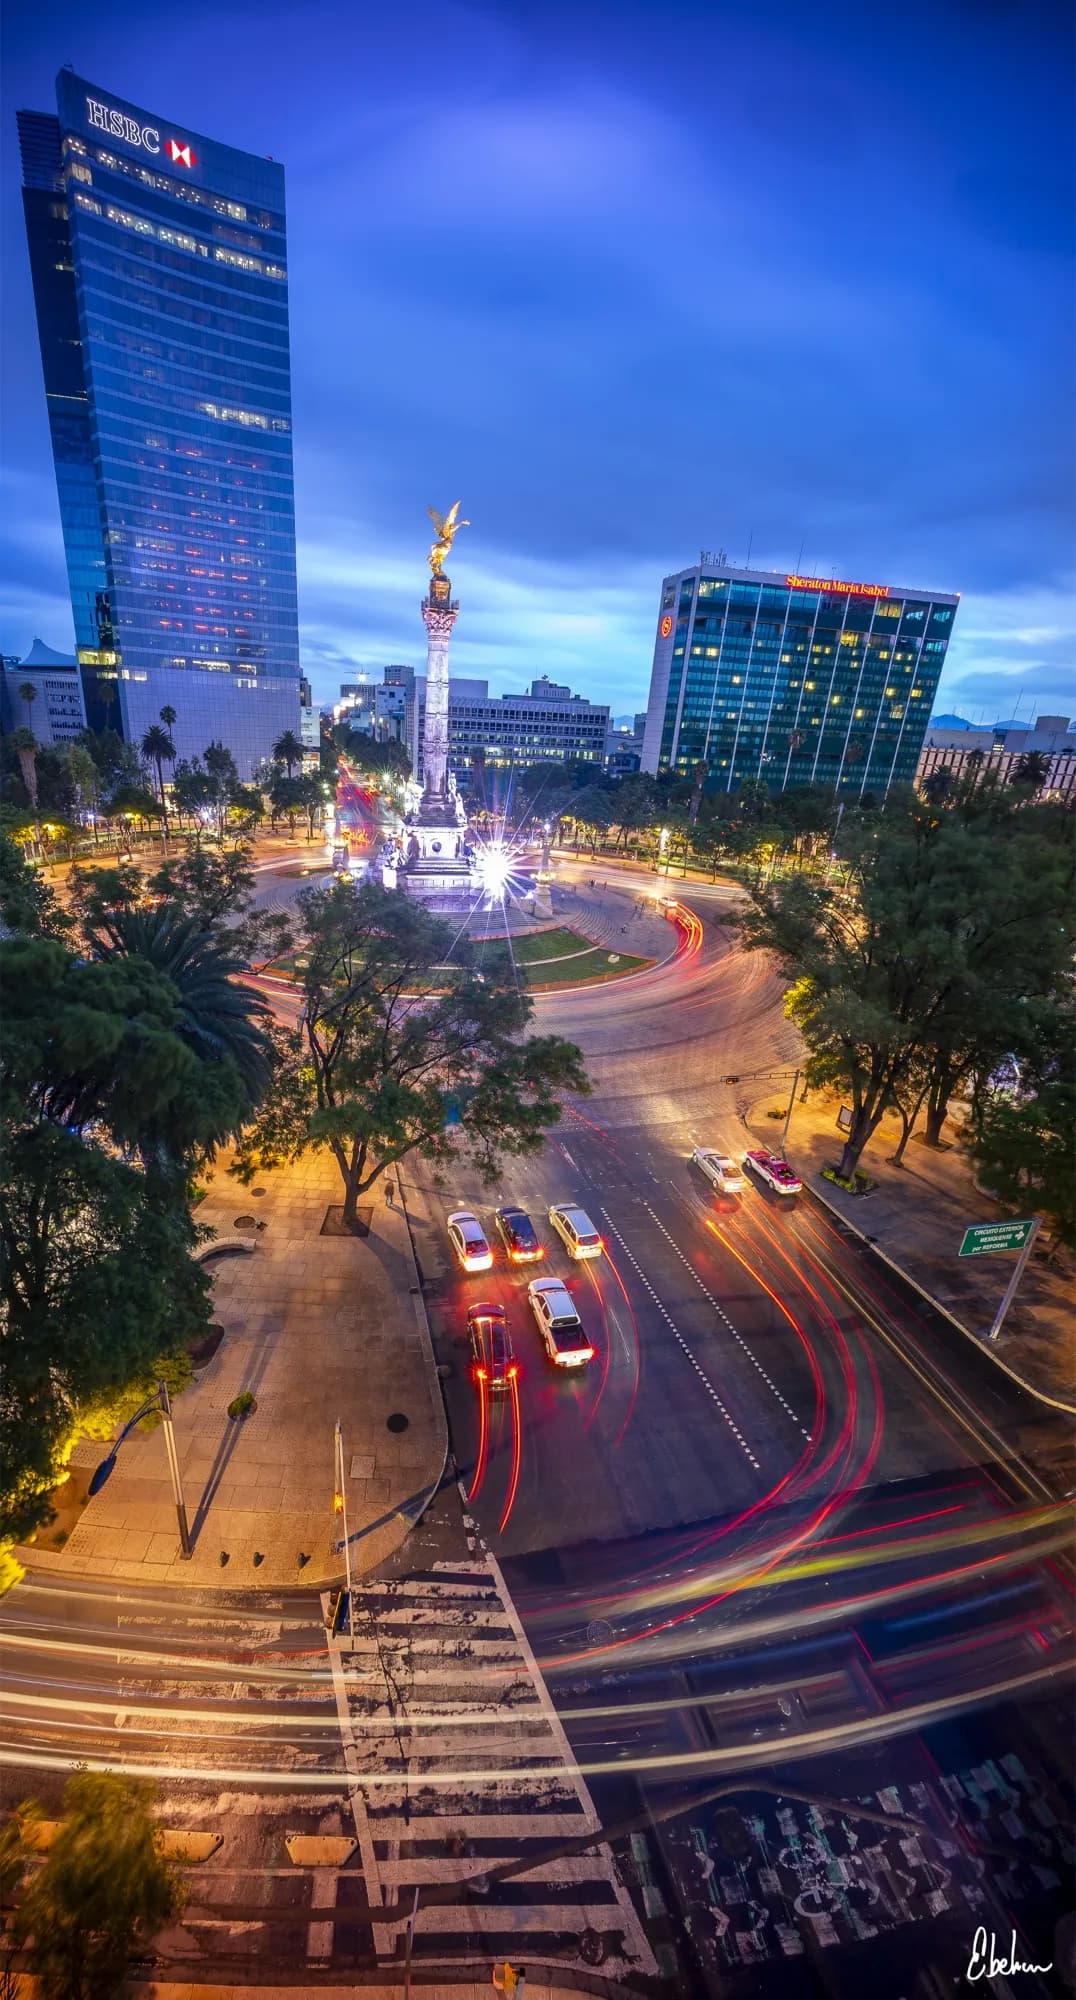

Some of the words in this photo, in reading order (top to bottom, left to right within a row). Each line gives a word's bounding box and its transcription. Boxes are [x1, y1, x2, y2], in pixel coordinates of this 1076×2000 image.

[86, 97, 160, 153] HSBC
[787, 575, 831, 591] Sheraton
[831, 580, 859, 593] Maria
[860, 583, 889, 597] Isabel
[974, 1227, 997, 1236] CIRCUITO
[998, 1225, 1024, 1233] EXTERIOR
[979, 1233, 1013, 1243] MEXIQUENSE
[981, 1242, 1008, 1250] REFORMA
